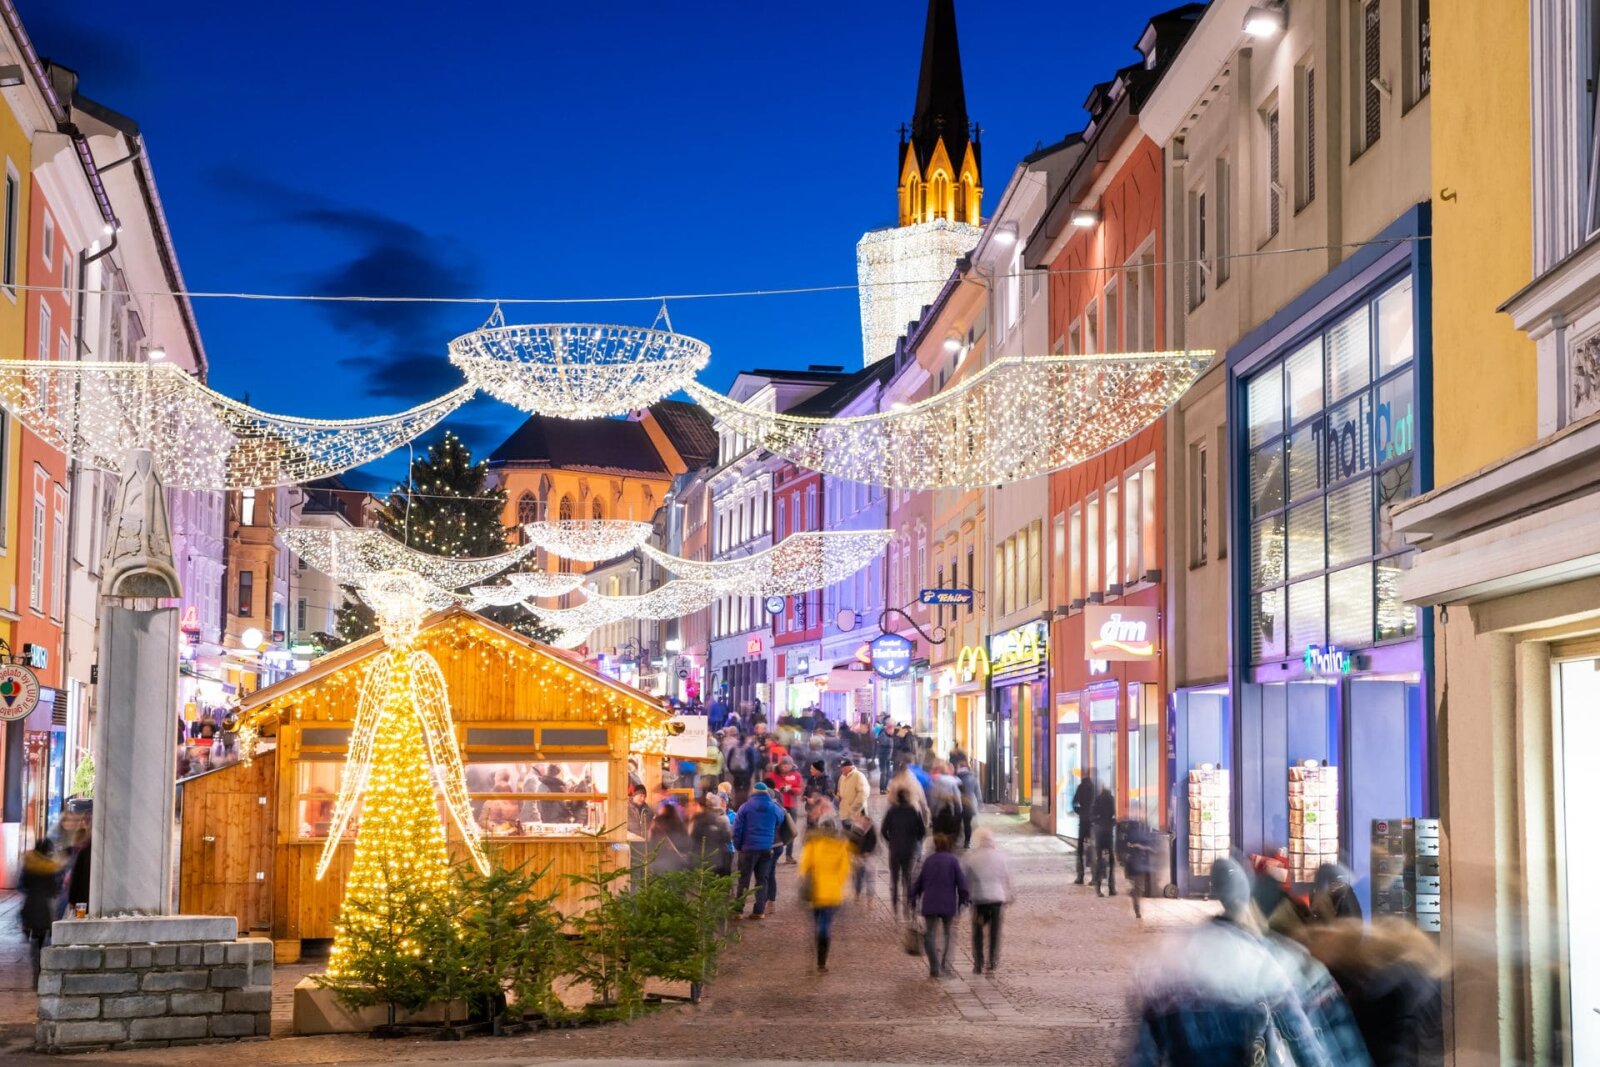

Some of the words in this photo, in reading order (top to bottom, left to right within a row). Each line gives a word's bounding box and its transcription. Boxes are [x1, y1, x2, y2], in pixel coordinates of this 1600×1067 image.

[937, 593, 971, 602] Tchibo
[1100, 613, 1147, 641] dm
[21, 674, 30, 684] by
